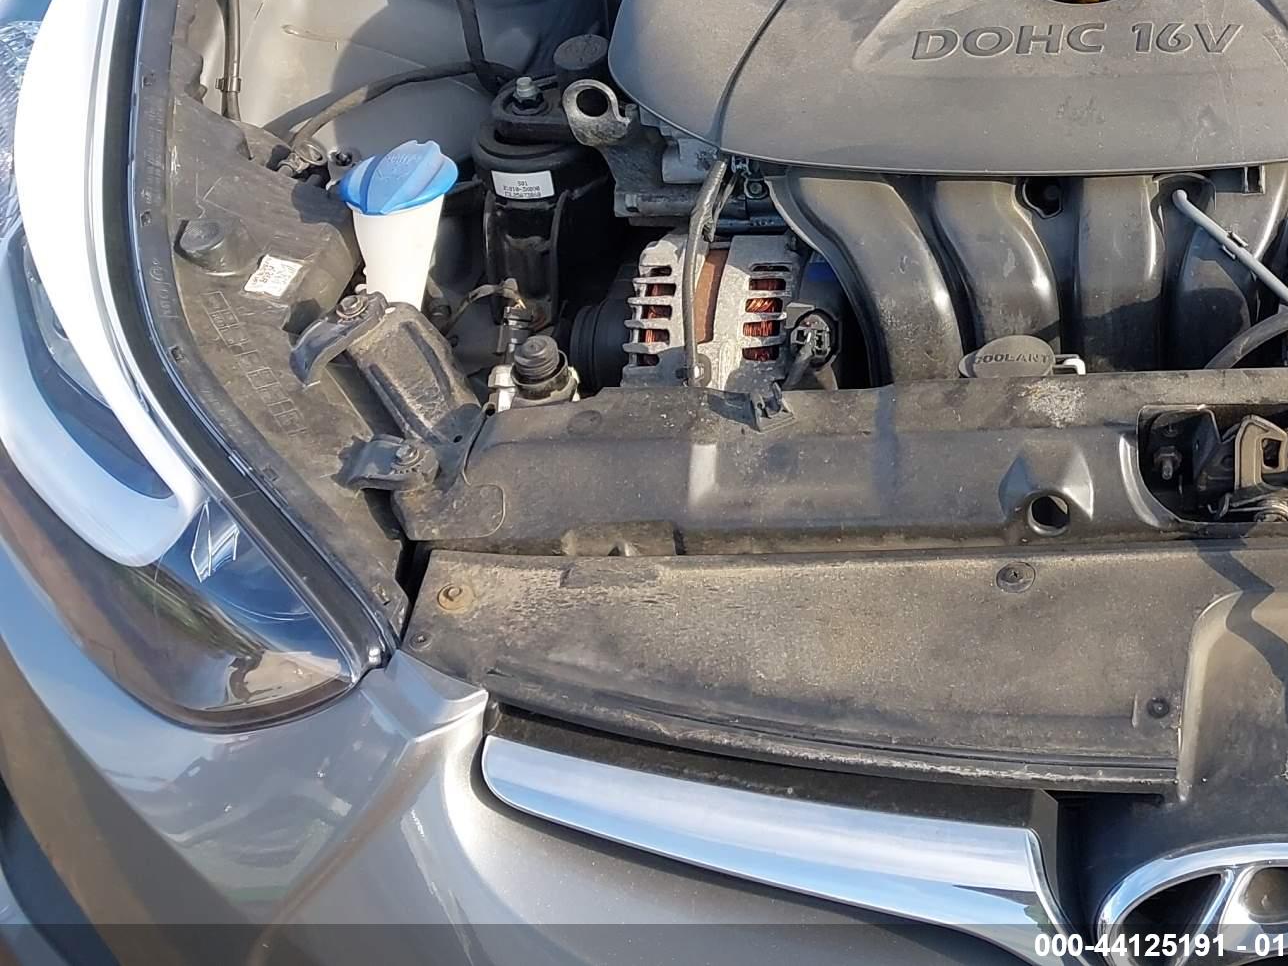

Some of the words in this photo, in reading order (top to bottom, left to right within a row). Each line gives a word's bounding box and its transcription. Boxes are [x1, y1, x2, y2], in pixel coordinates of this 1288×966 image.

[911, 23, 1107, 60] DOHC
[1131, 22, 1244, 55] 16V
[975, 353, 1050, 365] COOLANT
